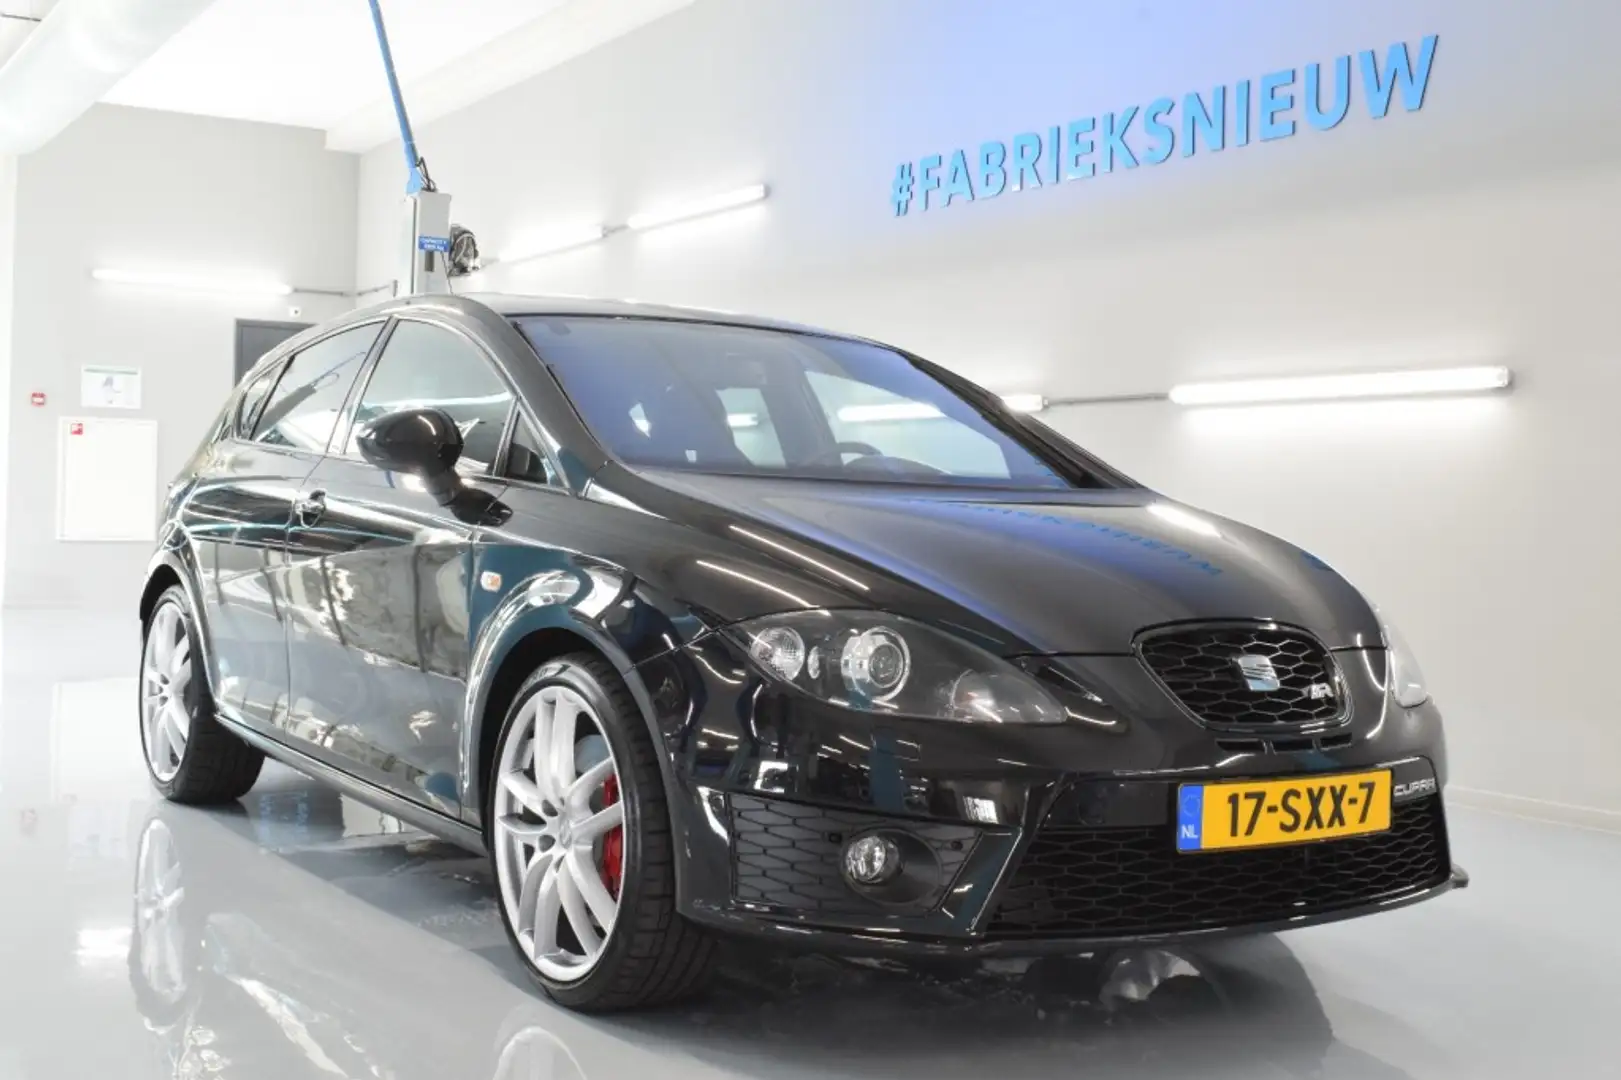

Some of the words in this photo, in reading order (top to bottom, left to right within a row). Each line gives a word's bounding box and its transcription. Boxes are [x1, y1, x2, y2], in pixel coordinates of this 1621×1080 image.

[891, 34, 1439, 217] #FABRIEKSNIEUW
[1181, 823, 1199, 839] NL
[1227, 781, 1376, 838] 17-SXX-7
